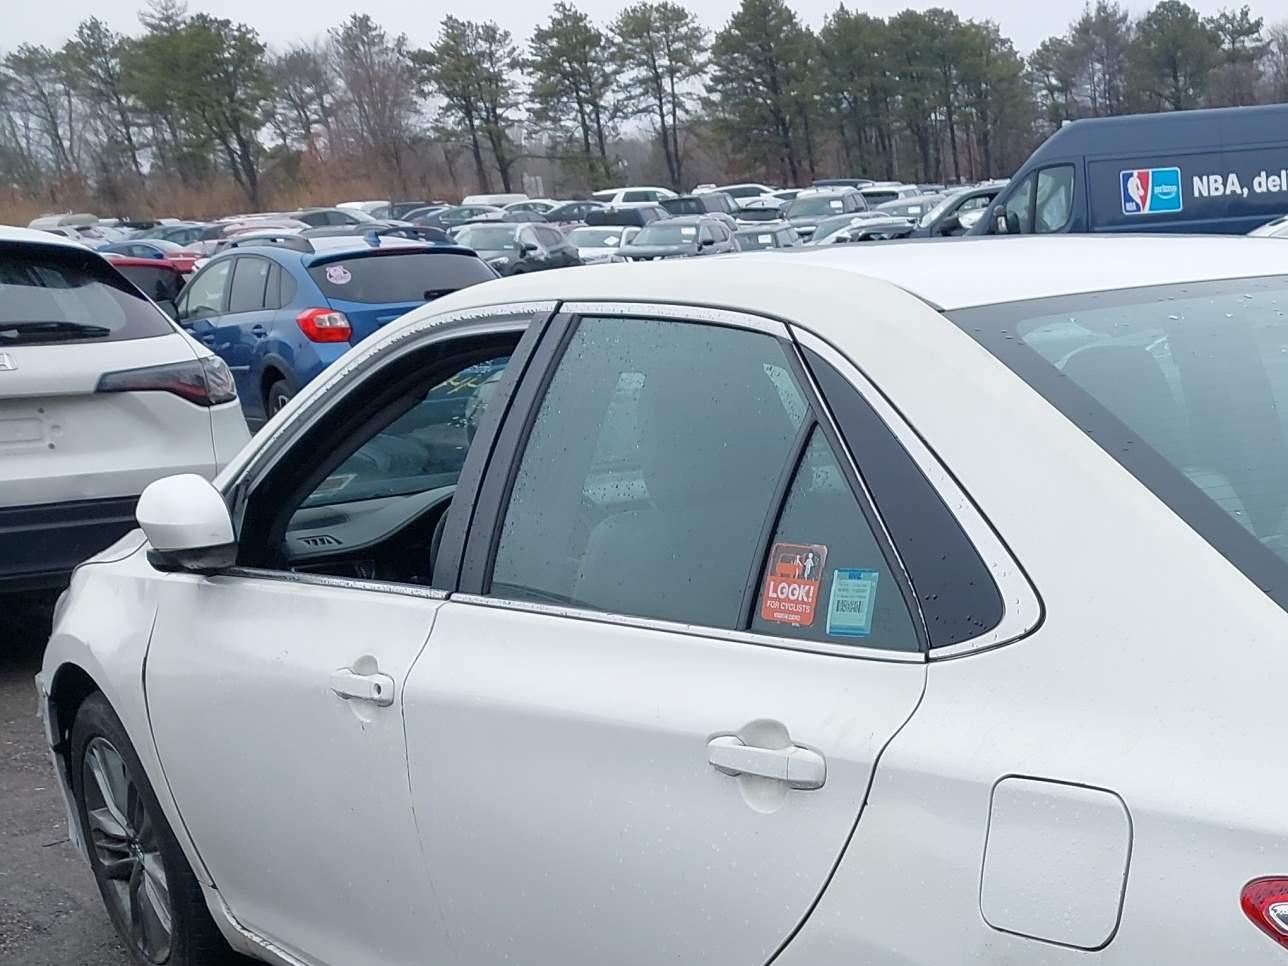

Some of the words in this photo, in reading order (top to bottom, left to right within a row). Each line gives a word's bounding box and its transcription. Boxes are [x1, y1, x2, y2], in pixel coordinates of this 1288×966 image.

[1192, 173, 1249, 198] NBA,
[768, 581, 814, 603] LOOK!
[766, 600, 780, 609] FOR
[780, 602, 811, 613] CYCLISTS
